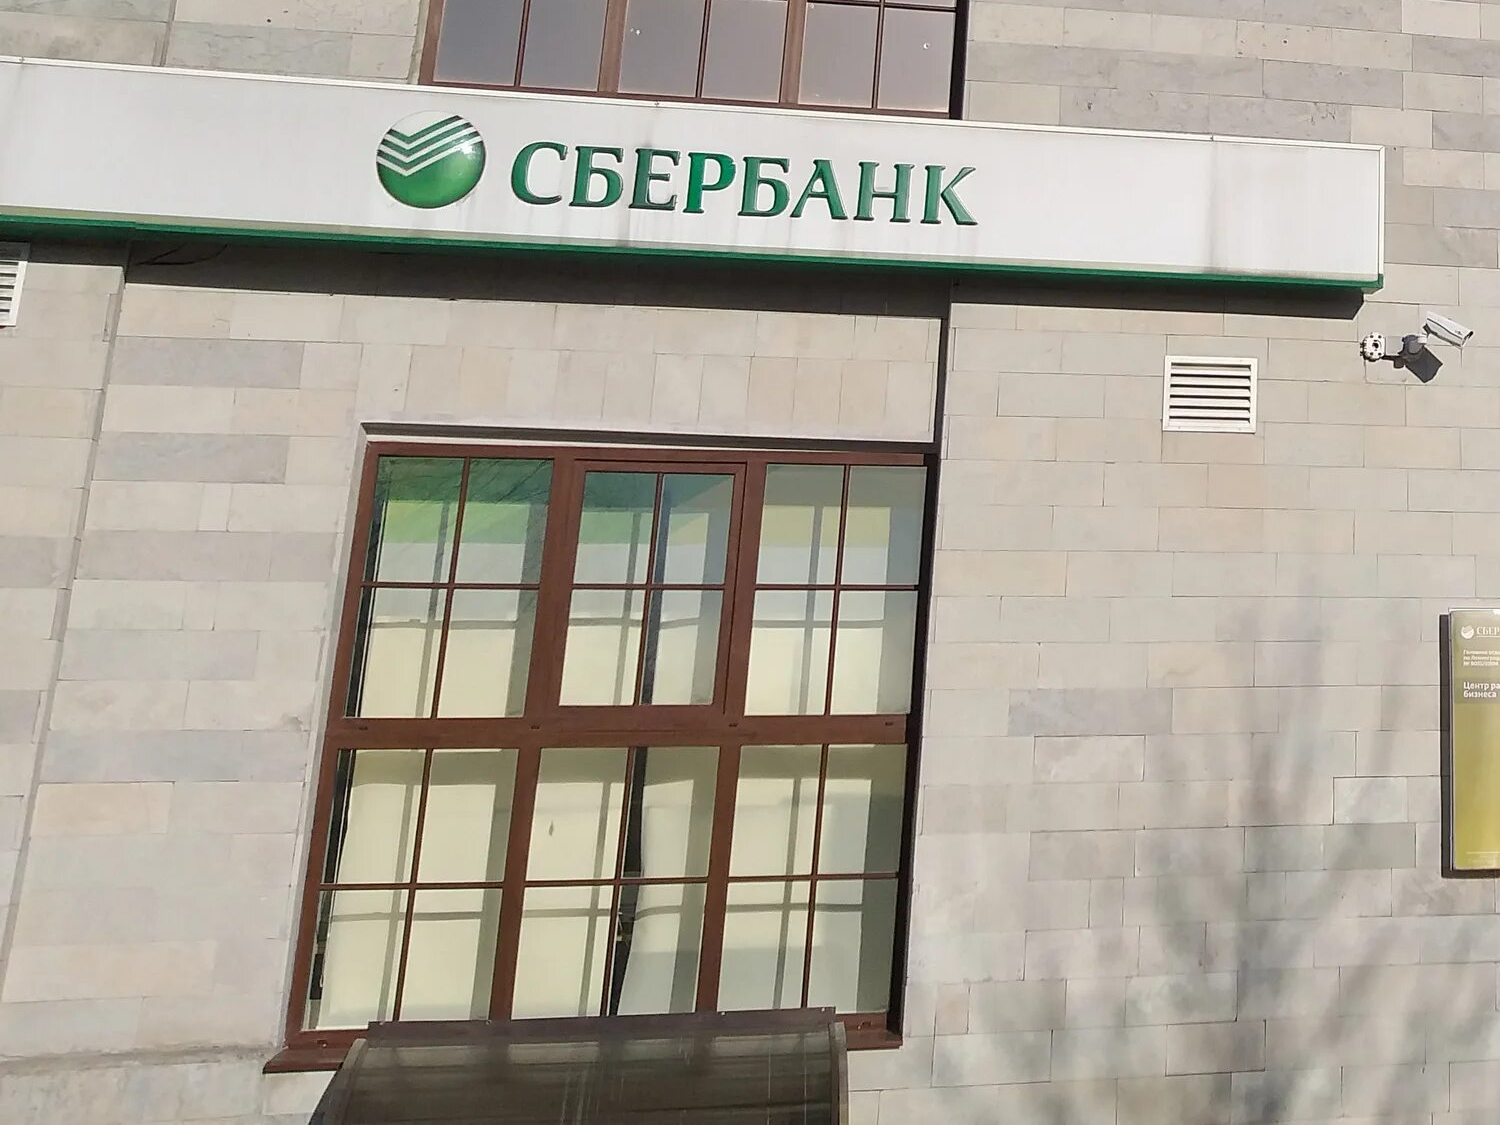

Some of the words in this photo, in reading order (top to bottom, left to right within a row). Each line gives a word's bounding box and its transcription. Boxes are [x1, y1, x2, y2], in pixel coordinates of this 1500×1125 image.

[510, 140, 979, 227] СБЕРБАНК
[1463, 681, 1489, 691] Центр
[1463, 690, 1497, 698] бизнеса
